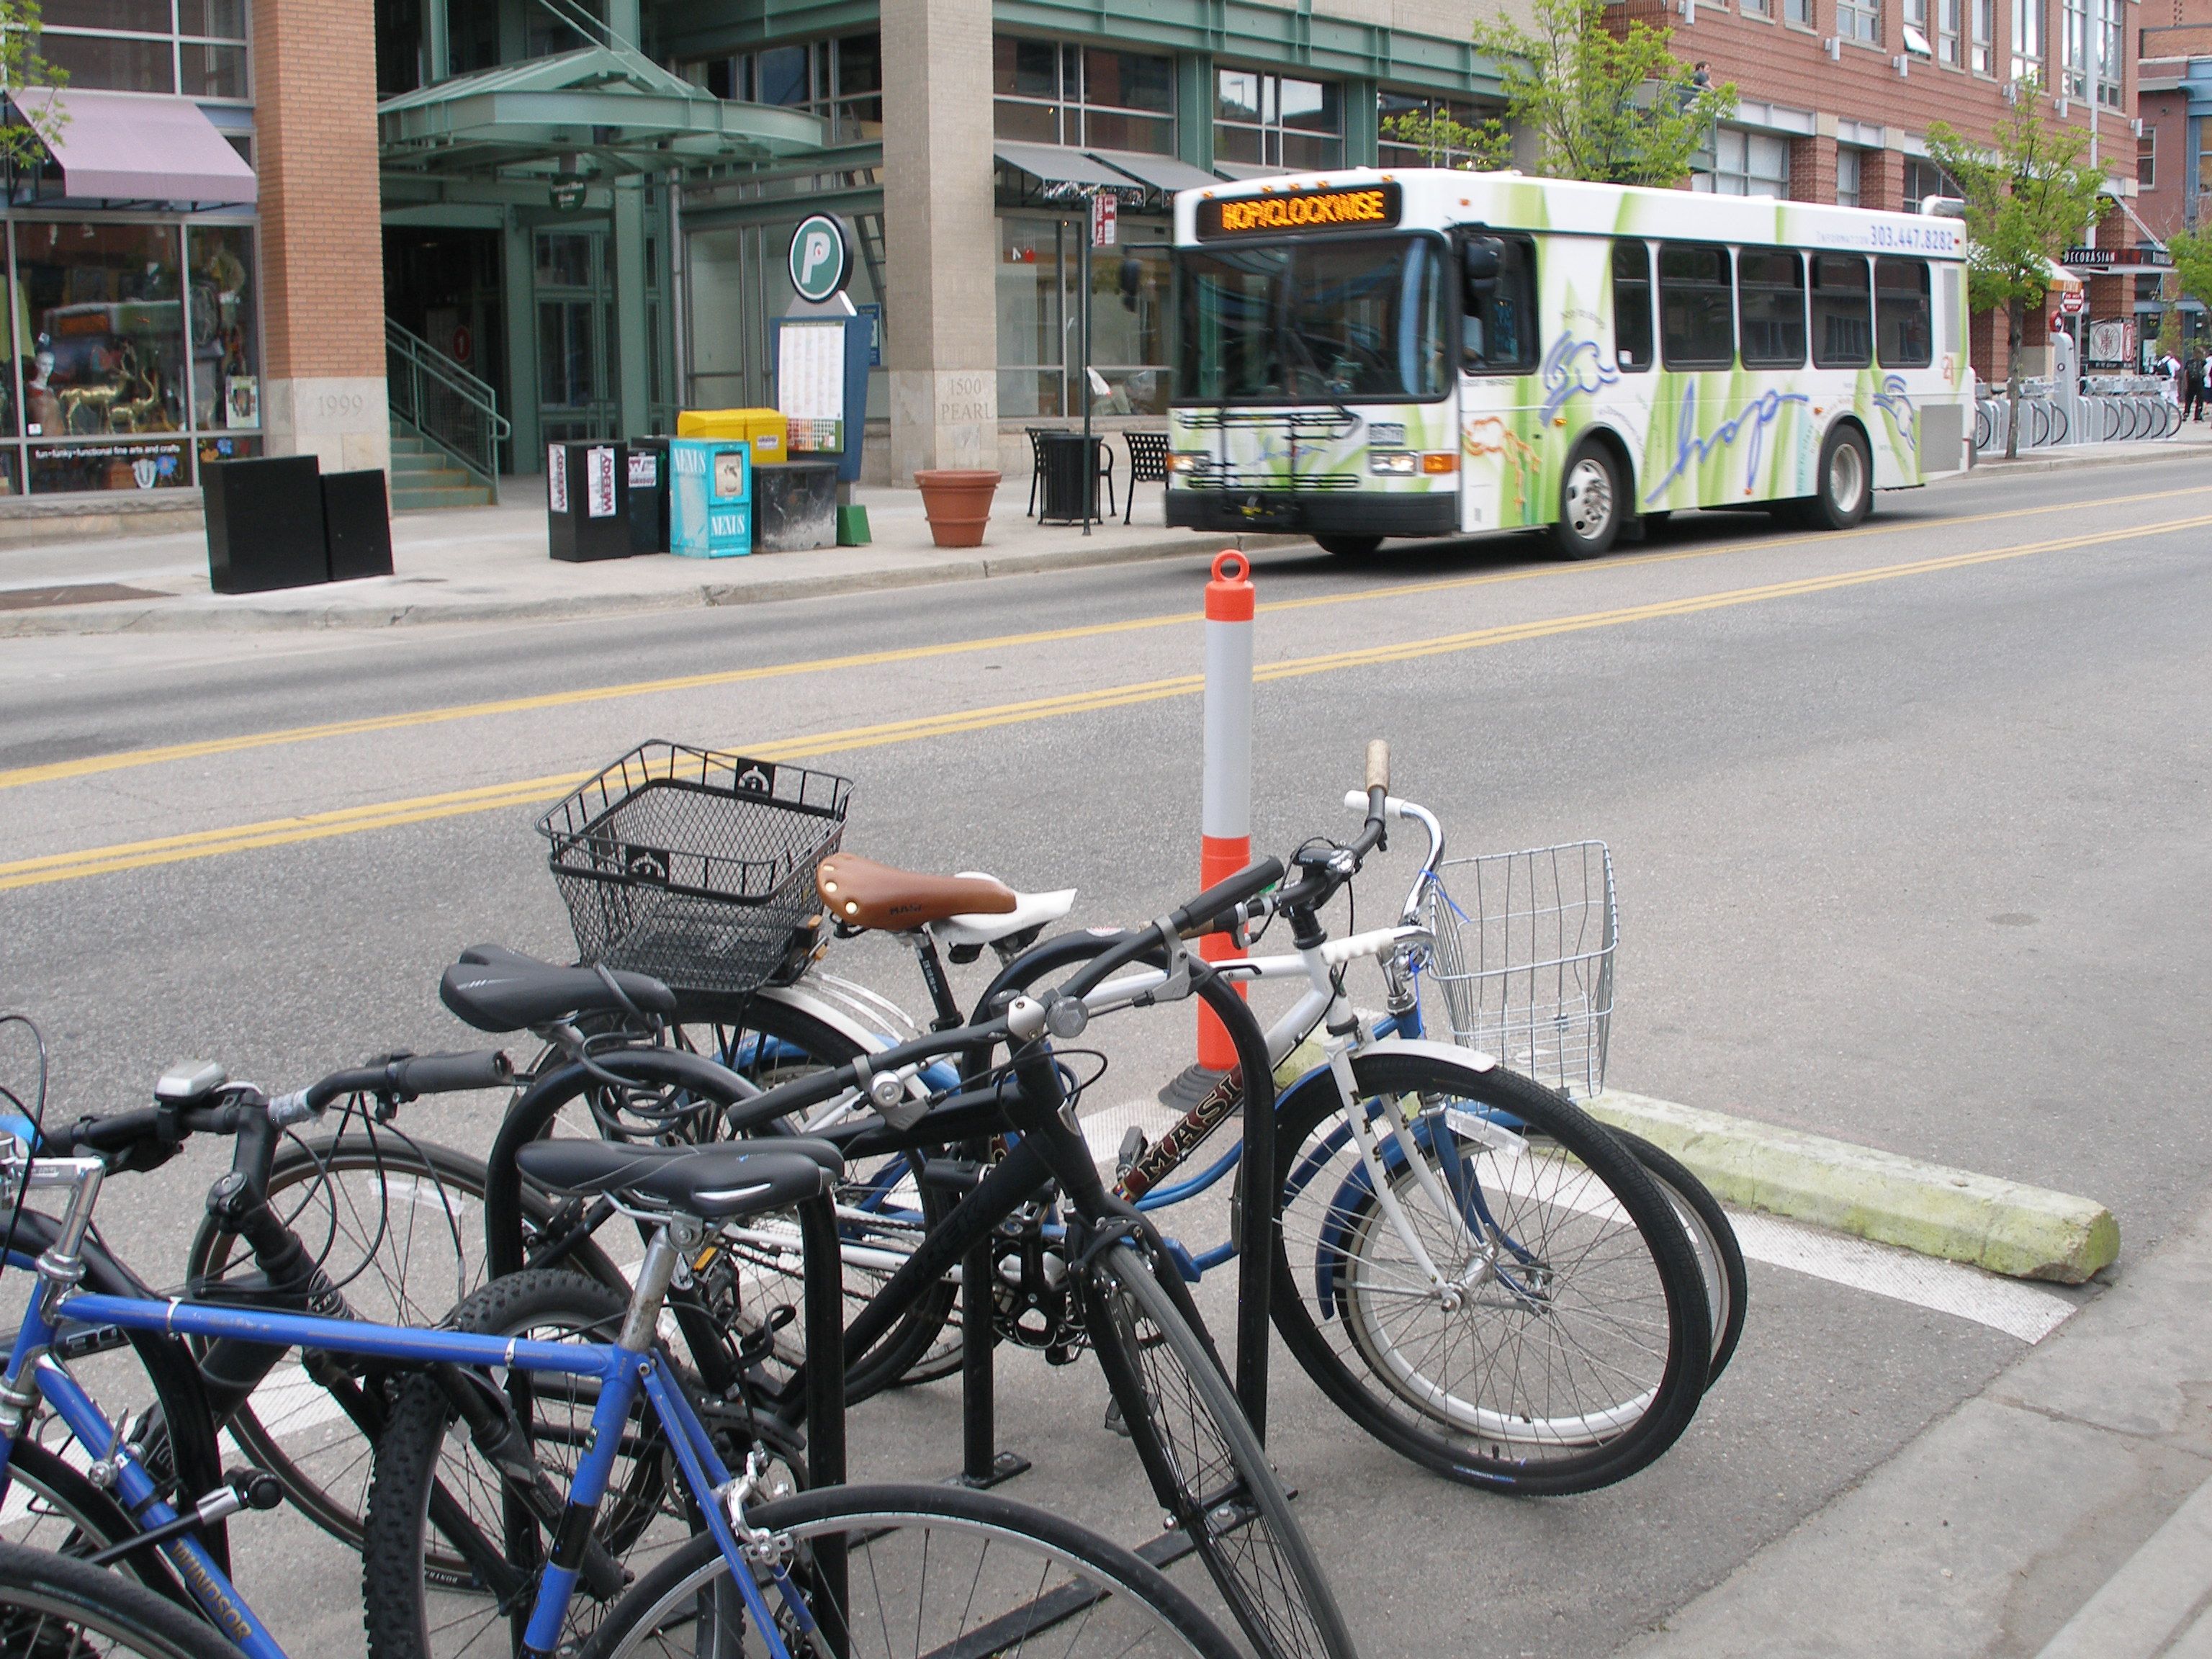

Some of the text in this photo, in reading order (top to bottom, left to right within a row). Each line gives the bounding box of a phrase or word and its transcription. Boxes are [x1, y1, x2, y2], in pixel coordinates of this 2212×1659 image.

[1871, 225, 1953, 251] 303.447.8282
[950, 377, 982, 395] 1500
[318, 395, 364, 417] 1999
[941, 402, 994, 420] PEARL
[145, 444, 159, 454] and
[674, 448, 707, 474] NEXUS
[711, 514, 745, 536] NEXUS
[1136, 1071, 1243, 1182] MASI
[172, 1537, 252, 1642] WINDSOR
